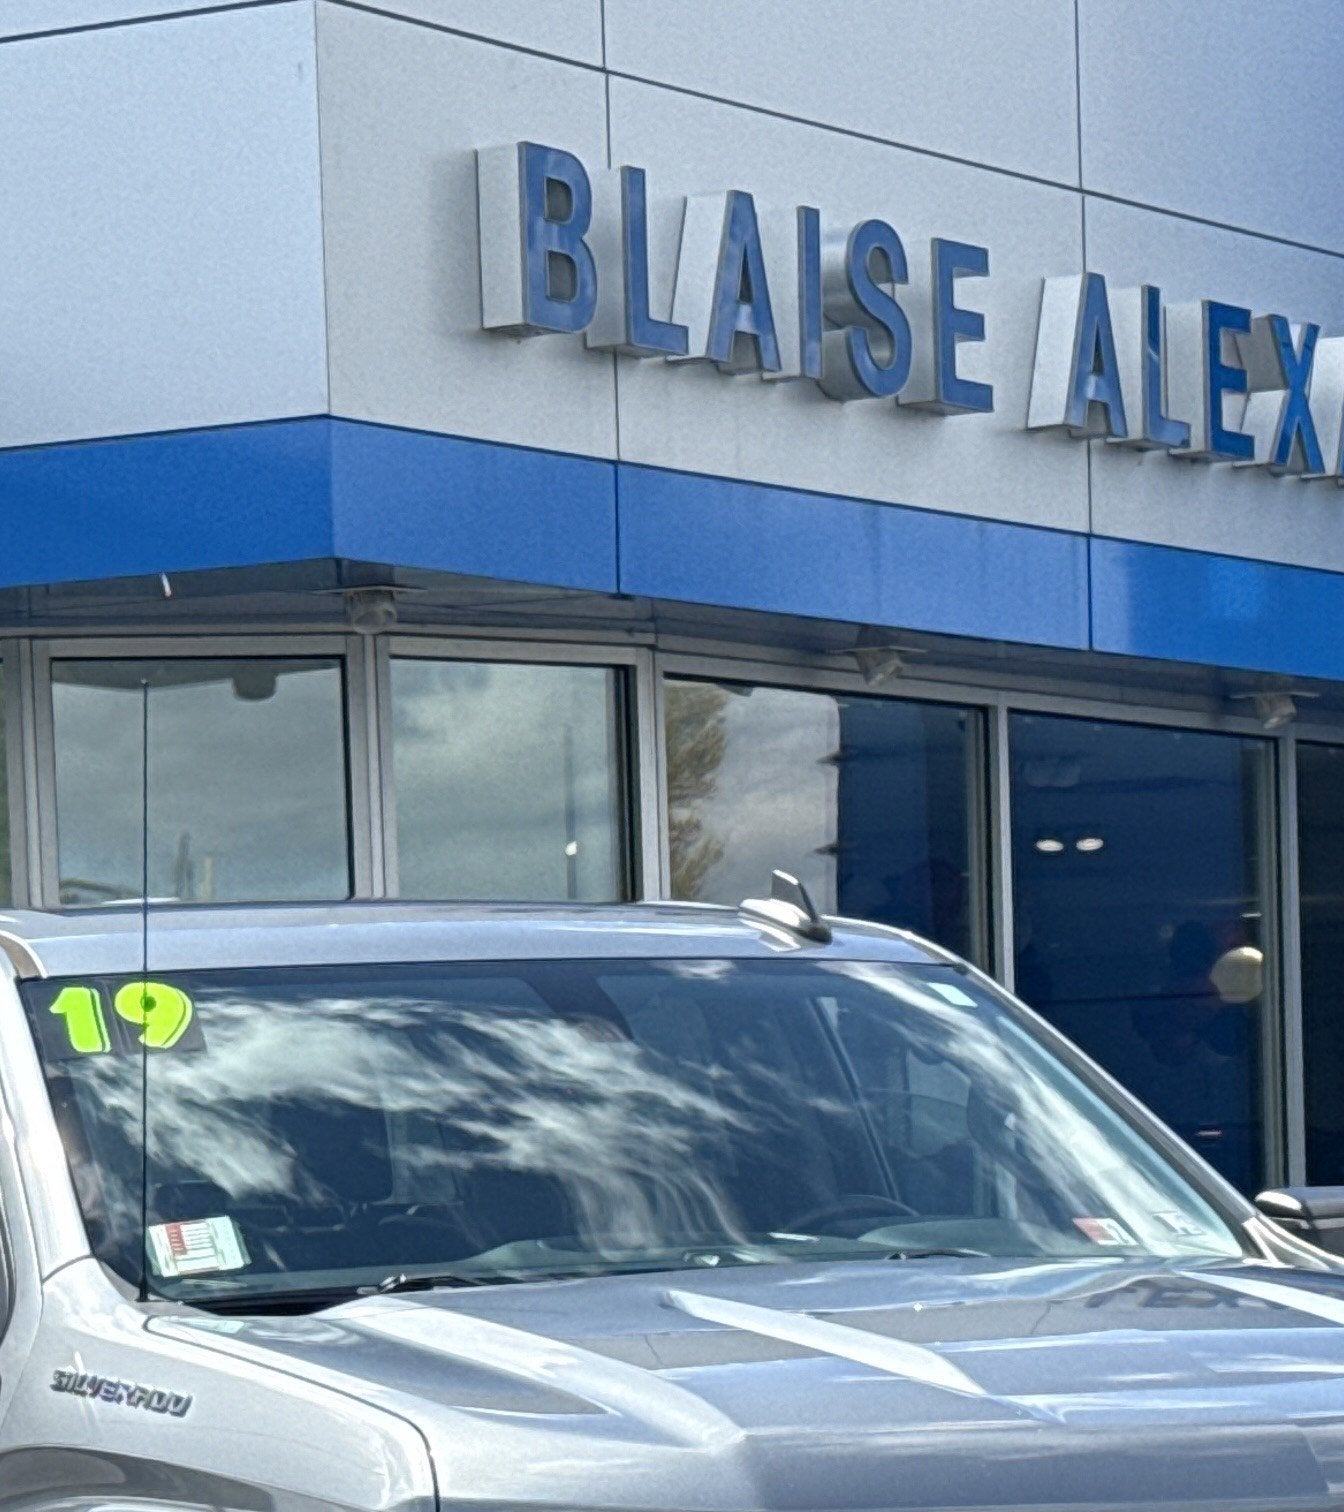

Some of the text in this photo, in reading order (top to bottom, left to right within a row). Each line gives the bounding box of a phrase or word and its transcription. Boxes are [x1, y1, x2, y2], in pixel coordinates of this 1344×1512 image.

[516, 140, 994, 414] BLAISE
[50, 981, 193, 1054] 19
[49, 1368, 193, 1418] SILVERADO
